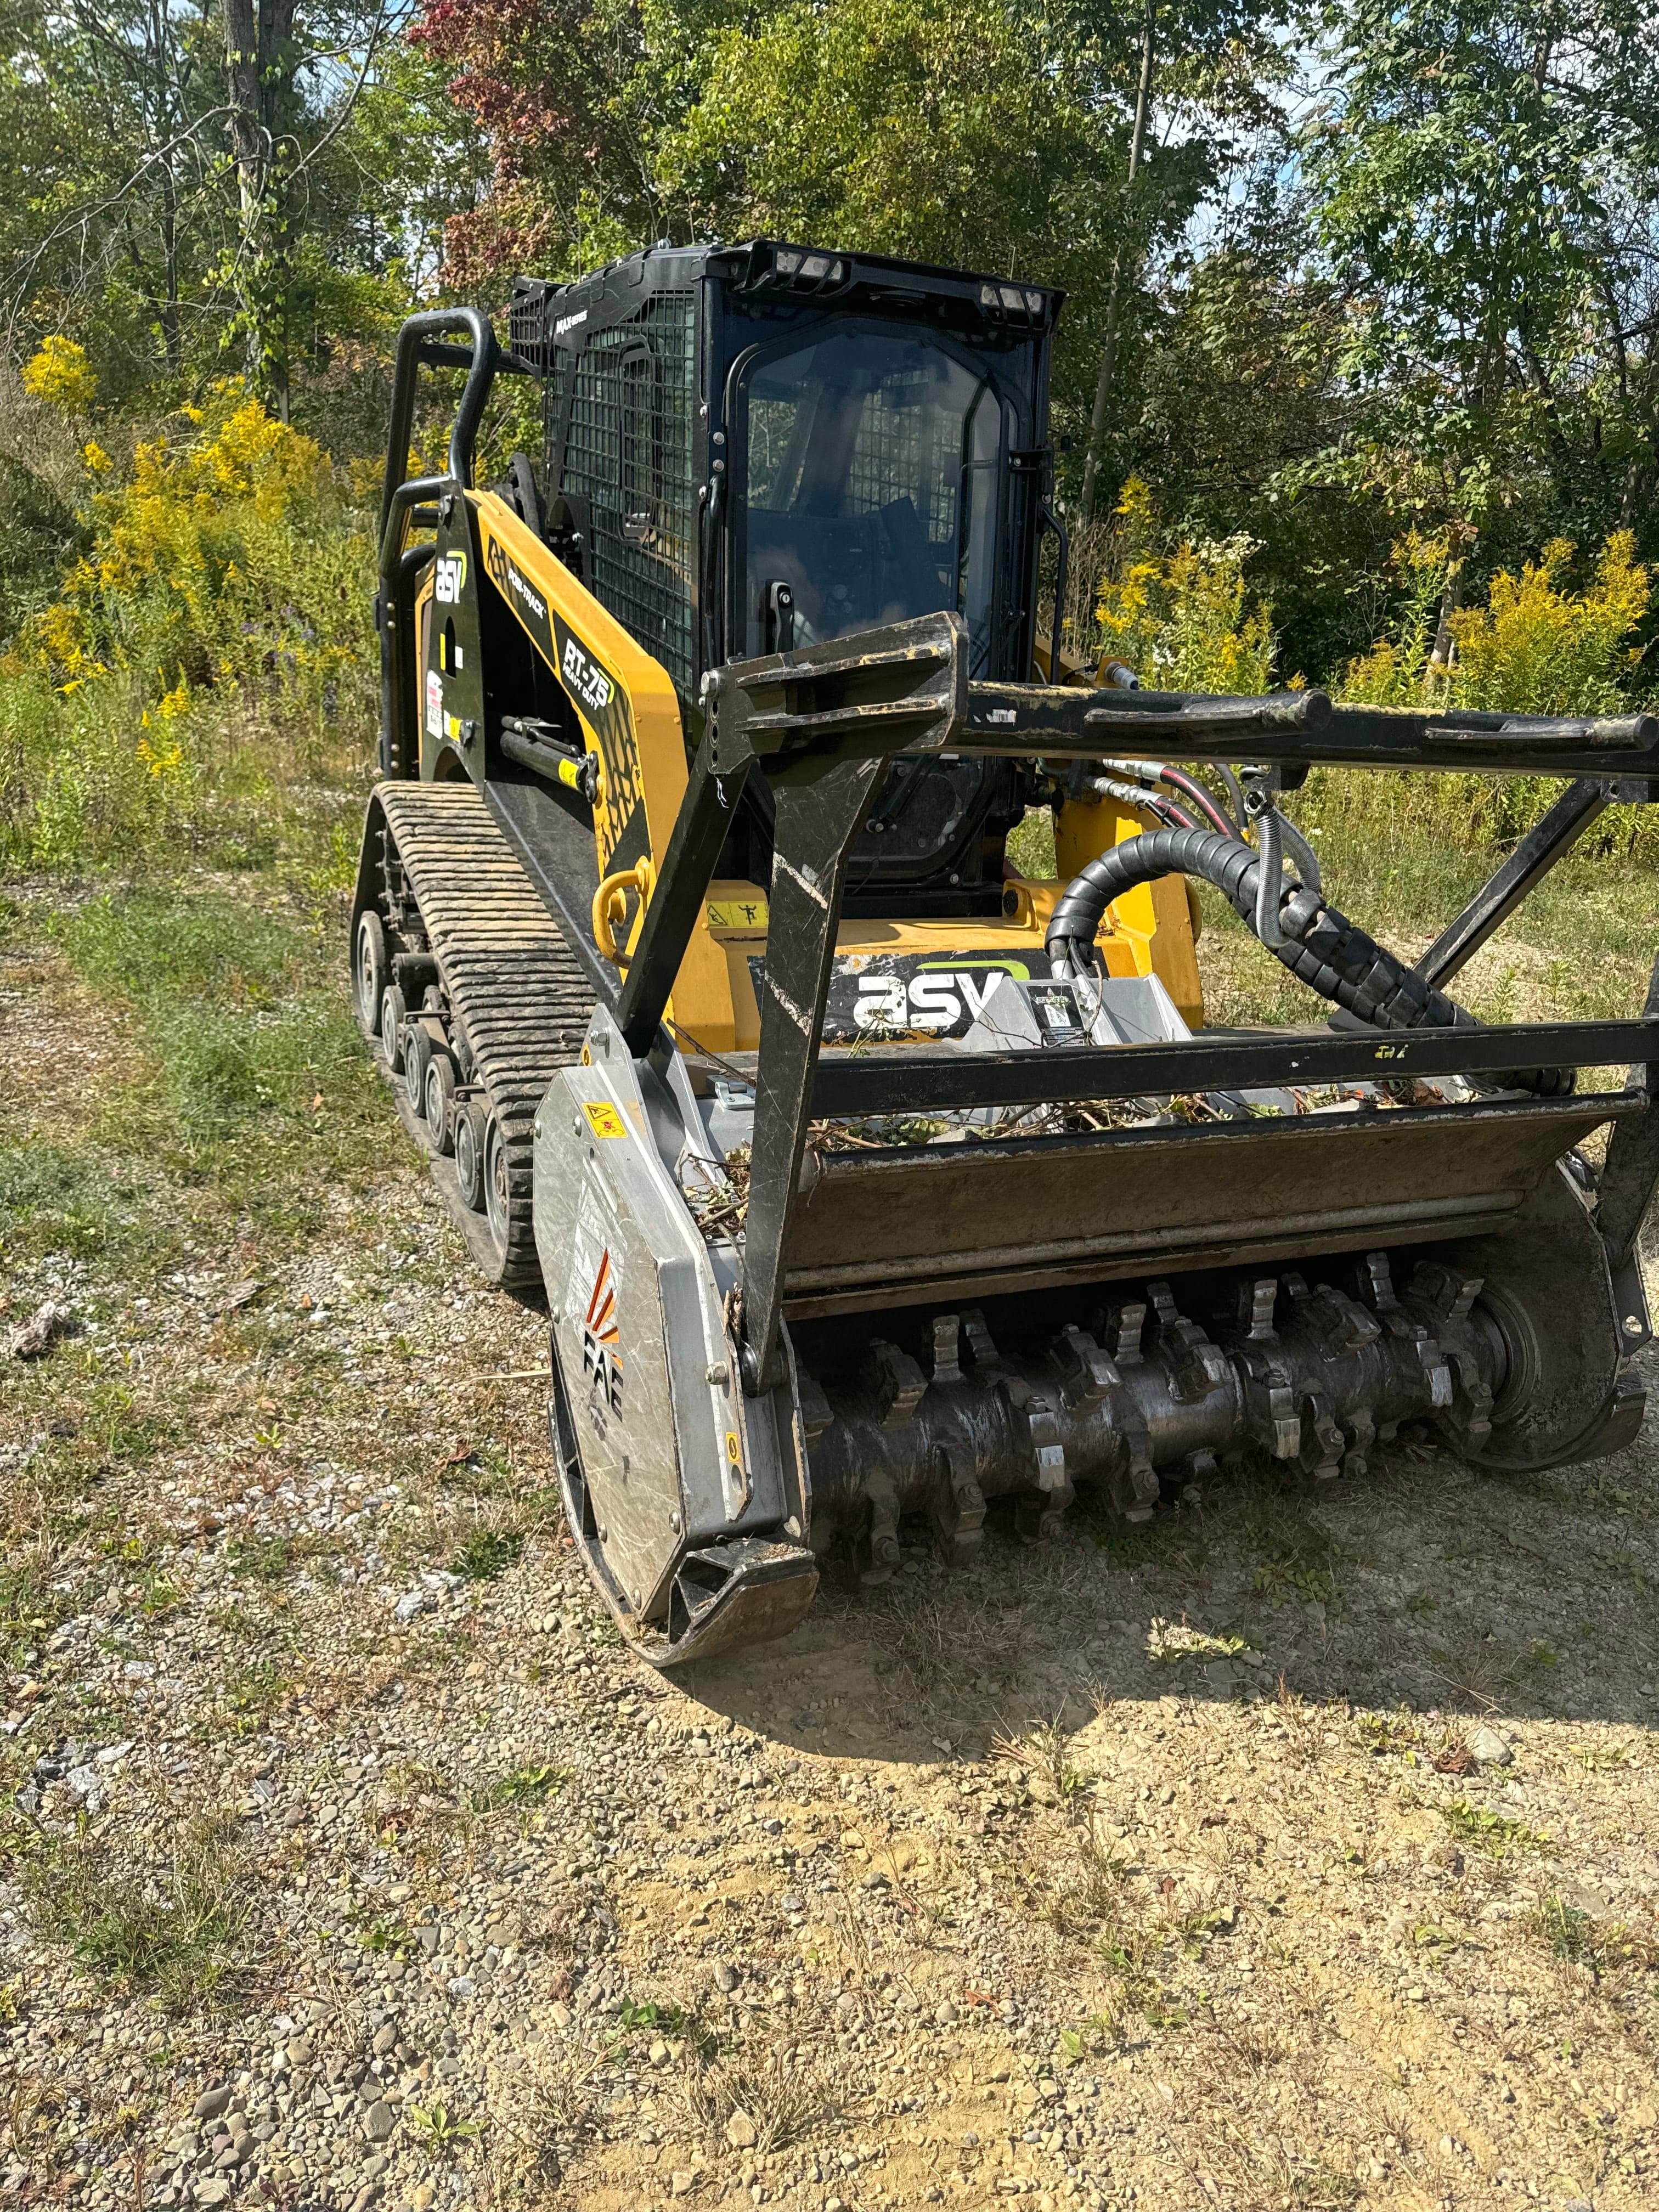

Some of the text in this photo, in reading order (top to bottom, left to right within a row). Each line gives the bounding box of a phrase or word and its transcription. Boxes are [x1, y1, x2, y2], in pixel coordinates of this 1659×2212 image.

[436, 559, 462, 603] asv
[562, 662, 599, 710] HEAVY DUTY
[564, 637, 610, 707] RT-75
[853, 972, 1004, 1030] asv
[584, 1329, 624, 1423] FAE
